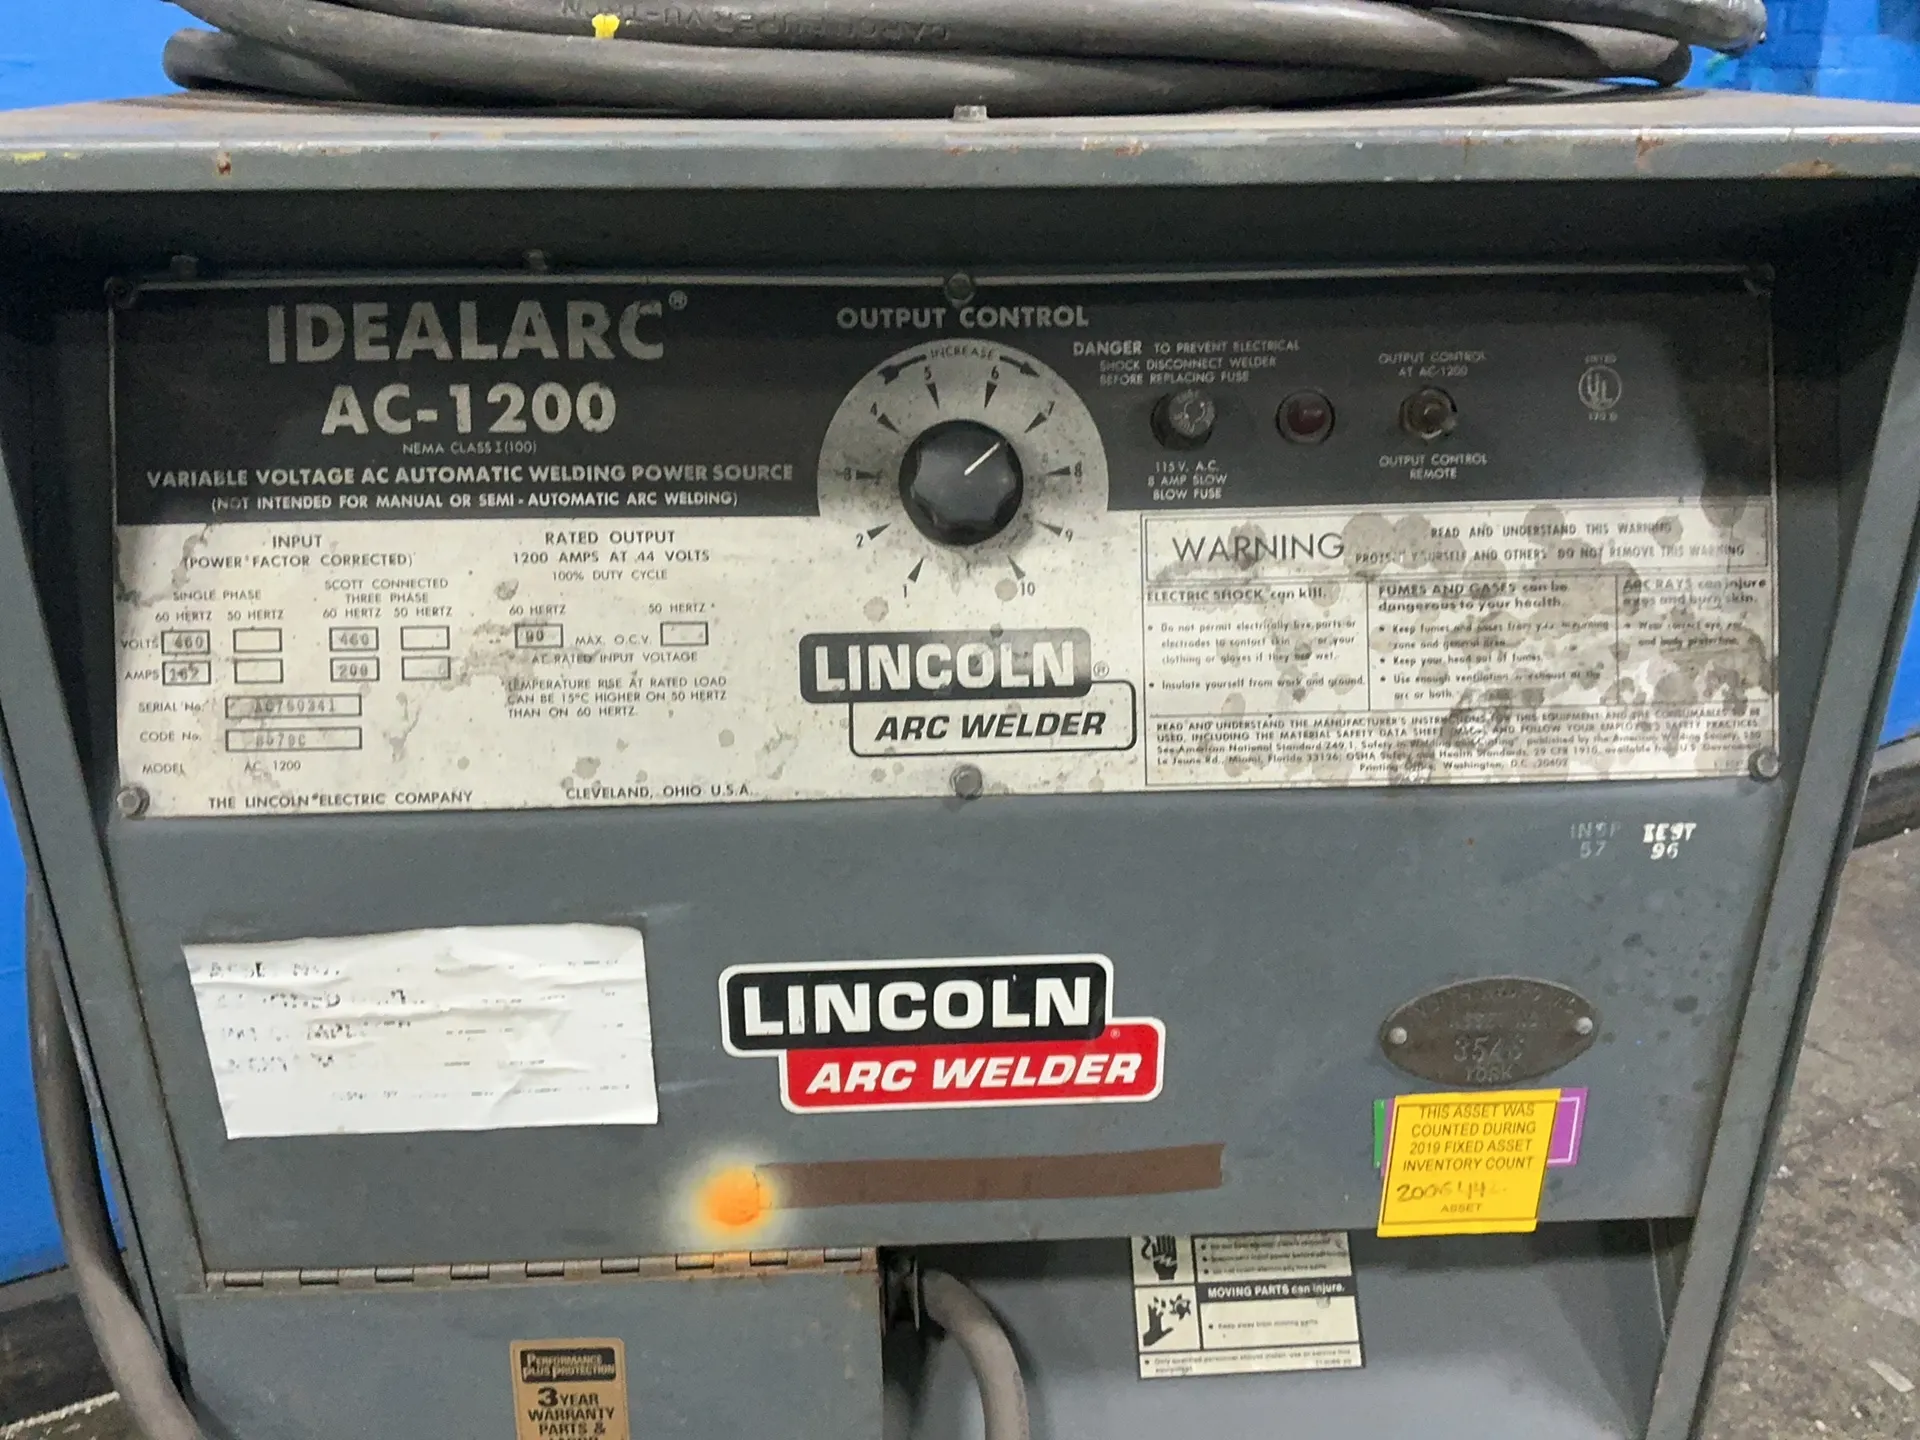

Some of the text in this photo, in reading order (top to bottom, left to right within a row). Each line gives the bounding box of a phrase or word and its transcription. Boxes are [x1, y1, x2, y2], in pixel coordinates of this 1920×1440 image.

[837, 305, 1089, 328] OUTPUT CONTROL
[928, 347, 993, 360] INCREASE
[1073, 340, 1300, 356] DANGER TO PREVENT ELECTRICAL
[1100, 357, 1276, 372] SHOCK DISCONNECT WELDER
[1379, 350, 1486, 365] OUTPUT CONTROL
[924, 366, 932, 380] 5
[991, 366, 999, 379] 6
[1100, 371, 1249, 385] BEFORE REPLACING FUSE
[321, 382, 616, 435] AC-1200
[870, 401, 878, 415] 4
[403, 442, 490, 456] NEMA CLASS
[1379, 453, 1488, 468] OUTPUT CONTROL
[147, 463, 793, 489] VARIABLE VOLTAGE AC AUTOMATIC WELDING POWER SOURCE
[1074, 463, 1082, 478] 8
[1410, 468, 1457, 480] REMOTE
[1161, 475, 1187, 486] AMP
[1153, 488, 1222, 500] BLOW FUSE
[211, 490, 738, 513] (NOT INTENDED FOR MANUAL OR ARC WELDING)
[545, 530, 676, 544] RATED OUTPUT
[1065, 529, 1073, 543] 9
[1431, 523, 1609, 538] READ AND UNDERSTAND THIS
[273, 535, 322, 549] INPUT
[856, 533, 864, 548] 2
[1172, 532, 1344, 563] WARNING
[513, 550, 710, 564] 1200 AMPS AT VOLTS
[1474, 545, 1684, 561] AND REMOVE THIS
[184, 553, 413, 569] (POWER FACTOR CORRECTED)
[552, 569, 668, 582] 100% DUTY CYCLE
[325, 578, 448, 590] SCOTT CONNECTED
[1020, 582, 1035, 596] 10
[1432, 582, 1464, 595] AND
[173, 590, 262, 601] SINGLE PHASE
[345, 592, 429, 604] THREE PHASE
[903, 586, 907, 597] 1
[1214, 588, 1295, 601] SHOCK can
[322, 608, 382, 619] 60 HERTZ
[394, 606, 452, 618] 50 HERTZ
[509, 604, 566, 616] 60 HERTZ
[649, 603, 662, 614] 50
[1378, 599, 1511, 614] dangerous your
[155, 610, 212, 622] 60 HERTZ
[227, 609, 284, 621] 50 HERTZ
[121, 636, 204, 649] VOLTS 460
[339, 634, 370, 646] 460
[600, 651, 698, 663] INPUT VOLTAGE
[815, 641, 1075, 692] LINCOLN
[125, 670, 160, 681] AMPS
[598, 679, 622, 689] RISE
[629, 678, 642, 688] AT
[650, 676, 688, 688] RATED
[694, 676, 727, 687] LOAD
[1205, 678, 1273, 692] yourself from
[507, 690, 727, 704] CAN BE HIGHER ON 50 HERTZ
[138, 702, 177, 713] SERIAL
[508, 707, 590, 718] THAN ON 60
[875, 712, 1107, 741] ARC WELDER
[140, 732, 175, 742] CODE
[142, 763, 184, 775] MODEL
[272, 760, 301, 771] 1200
[566, 784, 752, 800] CLEVELAND, OHIO U.S.A.
[208, 791, 473, 808] THE LINCOLN ELECTRIC COMPANY
[1650, 842, 1679, 860] 96
[742, 976, 1091, 1037] LINCOLN
[806, 1052, 1143, 1095] ARC WELDER
[1419, 1103, 1534, 1119] THIS ASSET WAS
[1411, 1121, 1536, 1138] COUNTED DURING
[1410, 1139, 1532, 1156] 2019 FIXED ASSET
[1403, 1156, 1534, 1172] INVENTORY COUNT
[1441, 1203, 1483, 1213] ASSET
[1208, 1283, 1344, 1298] MOVING PARTS injure.
[538, 1387, 599, 1406] 3 YEAR
[528, 1407, 614, 1421] WARRANTY
[539, 1423, 587, 1435] PARTS
